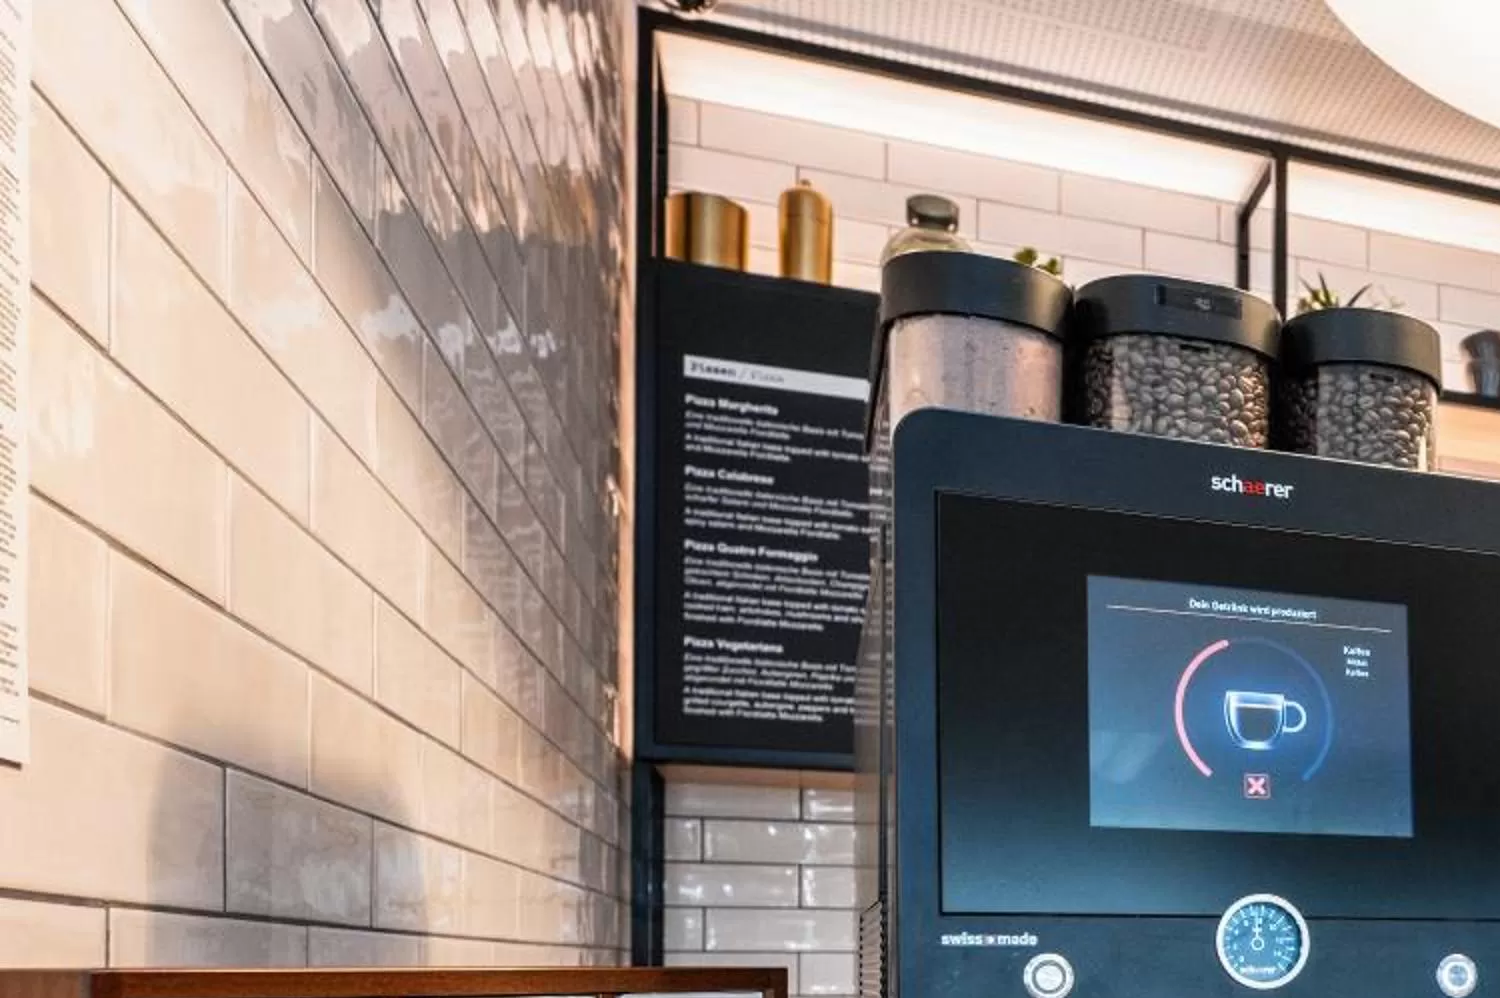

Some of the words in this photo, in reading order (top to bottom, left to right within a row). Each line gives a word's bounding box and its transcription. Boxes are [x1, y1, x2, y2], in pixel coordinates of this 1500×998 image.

[684, 393, 716, 408] Pizza
[718, 397, 779, 416] Margherita
[684, 465, 715, 479] Pizza
[718, 468, 774, 485] Calabrese
[1211, 474, 1294, 499] schaerer
[684, 537, 715, 552] Pizza
[684, 635, 714, 648] Pizza
[941, 931, 983, 945] swiss
[997, 931, 1038, 946] made
